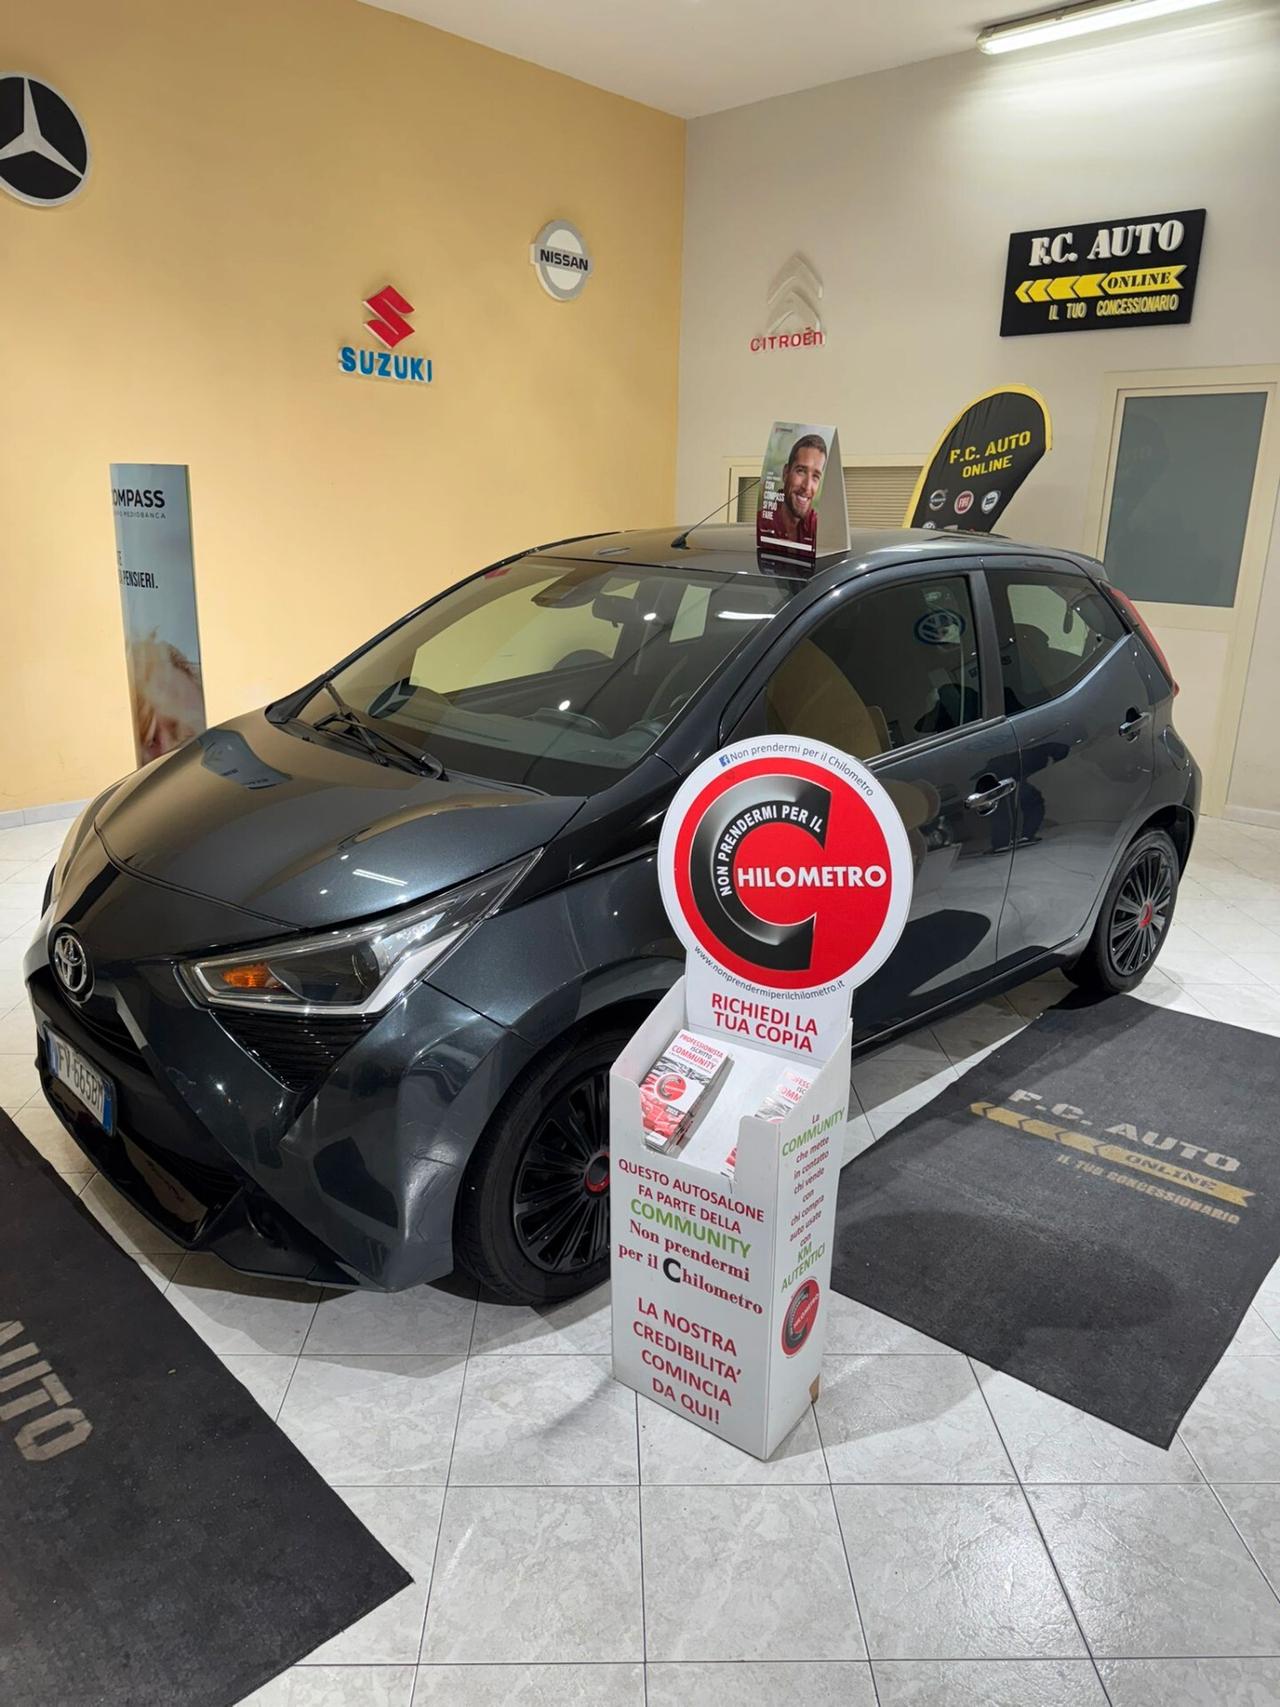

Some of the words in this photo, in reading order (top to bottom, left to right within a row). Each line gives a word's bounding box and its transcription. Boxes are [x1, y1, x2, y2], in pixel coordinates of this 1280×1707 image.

[540, 249, 588, 271] NISSAN
[1029, 232, 1078, 266] F.C.
[1087, 220, 1185, 259] AUTO
[1107, 272, 1171, 289] ONLINE
[1049, 304, 1059, 320] IL
[1067, 302, 1087, 318] TUO
[1096, 294, 1179, 316] CONCESSIONARIO
[340, 346, 432, 382] SUZUKI
[949, 446, 980, 464] F.C.
[985, 430, 1031, 456] AUTO
[962, 455, 1013, 478] ONLINE
[730, 749, 749, 762] Non
[751, 743, 801, 756] prendermi
[802, 746, 819, 758] per
[820, 751, 828, 761] il
[828, 756, 874, 796] Chilometro
[782, 805, 809, 823] PER
[809, 815, 823, 833] IL
[718, 805, 777, 861] PRENDERMI
[716, 866, 732, 897] NON
[694, 945, 845, 1000] www.nonprendermiperilchilometro.it
[711, 993, 790, 1027] RICHIEDI
[796, 1015, 818, 1036] LA
[713, 1011, 750, 1035] TUA
[755, 1023, 812, 1053] COPIA
[671, 1045, 717, 1070] COMMUNITY
[782, 1107, 845, 1156] COMMUNITY
[812, 1114, 820, 1124] La
[1008, 1089, 1093, 1126] F.C.
[1104, 1122, 1241, 1172] AUTO
[794, 1169, 800, 1180] in
[802, 1150, 829, 1174] contatto
[796, 1150, 809, 1163] che
[810, 1136, 829, 1154] mette
[618, 1158, 669, 1186] QUESTO
[673, 1179, 764, 1223] AUTOSALONE
[794, 1179, 804, 1194] chi
[805, 1167, 824, 1186] vende
[1056, 1154, 1070, 1165] IL
[1076, 1160, 1103, 1175] TUO
[1107, 1172, 1240, 1225] CONCESSIONARIO
[1125, 1154, 1218, 1191] ONLINE
[638, 1184, 653, 1200] FA
[657, 1191, 696, 1216] PARTE
[700, 1208, 741, 1235] DELLA
[791, 1210, 800, 1226] chi
[801, 1194, 824, 1218] compra
[803, 1189, 814, 1202] con
[630, 1198, 752, 1259] COMMUNITY
[790, 1225, 804, 1242] auto
[800, 1233, 811, 1247] con
[629, 1219, 660, 1244] Non
[664, 1237, 750, 1282] prendermi
[781, 1242, 825, 1293] AUTENTICI
[798, 1241, 812, 1263] KM
[618, 1244, 643, 1263] per
[648, 1253, 658, 1269] il
[663, 1257, 763, 1315] Chilometro
[638, 1297, 658, 1320] LA
[664, 1309, 737, 1357] NOSTRA
[641, 1349, 732, 1407] COMINCIA
[653, 1377, 676, 1402] DA
[680, 1393, 719, 1425] QUI!
